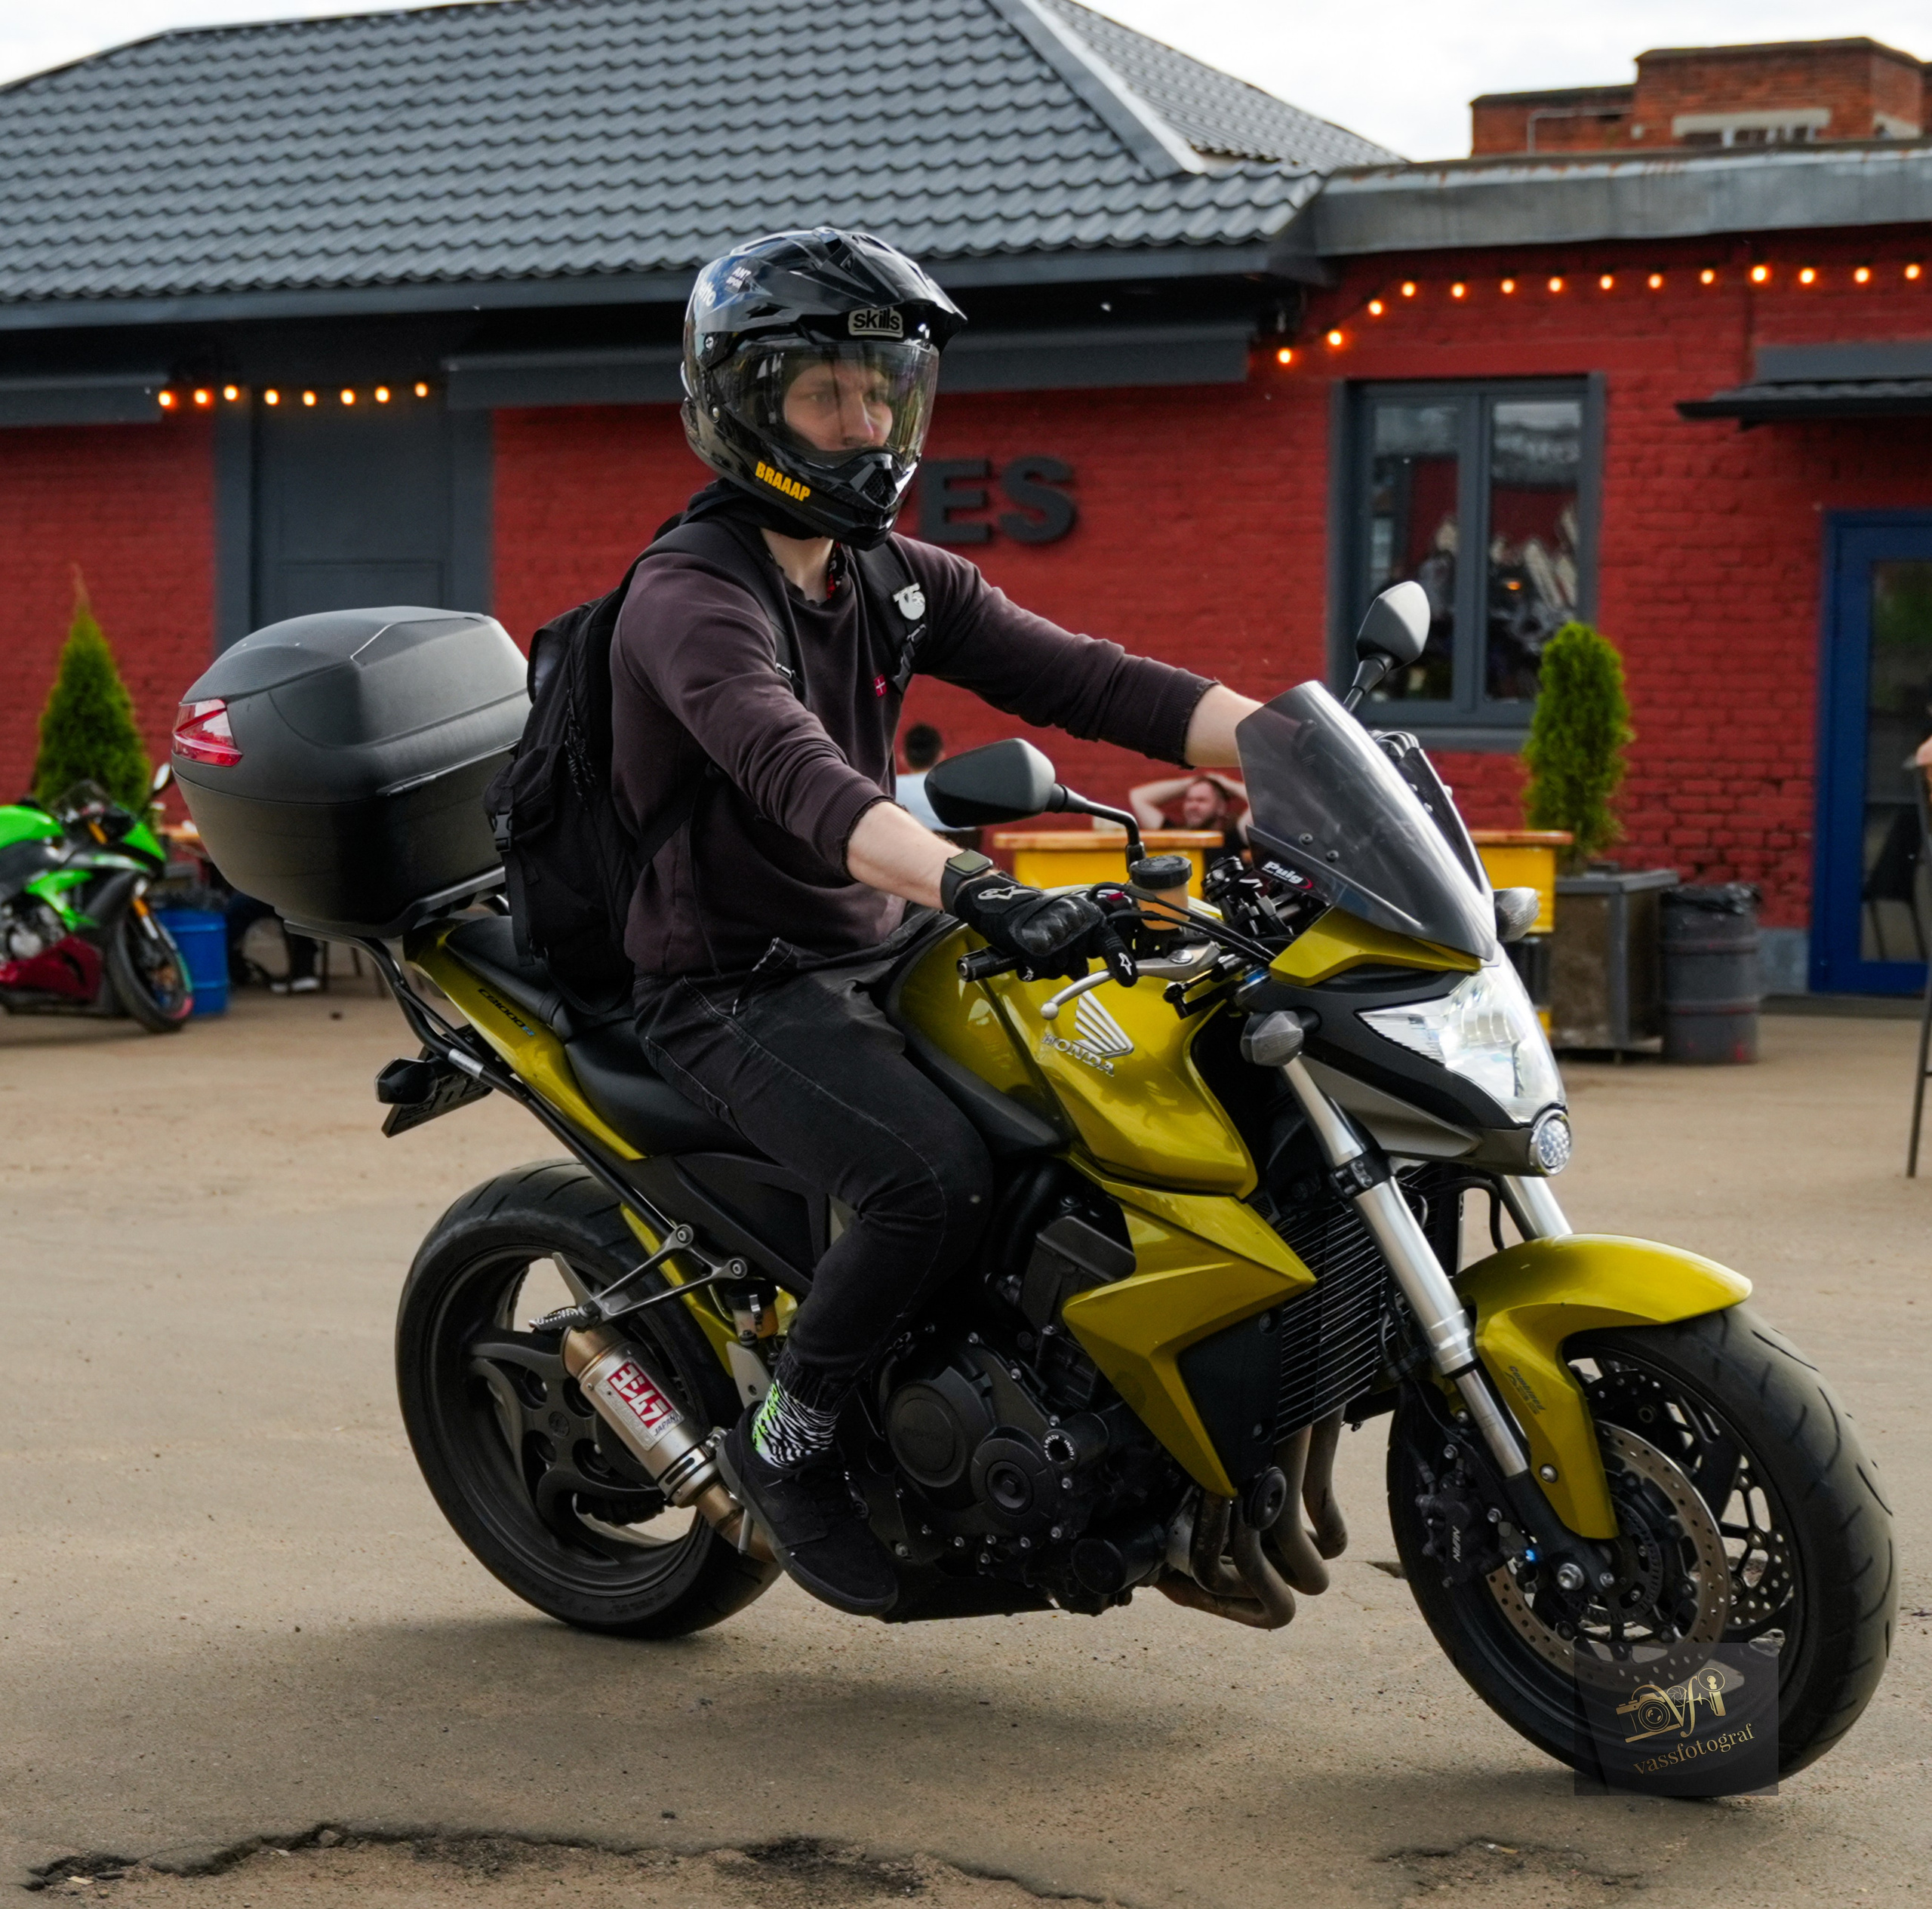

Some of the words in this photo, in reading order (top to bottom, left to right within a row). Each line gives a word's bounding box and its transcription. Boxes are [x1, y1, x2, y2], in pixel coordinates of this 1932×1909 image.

[853, 307, 900, 330] skills
[755, 460, 811, 502] BRAAAP
[1262, 861, 1304, 884] Puig
[1041, 1032, 1115, 1077] HONDA
[610, 1363, 670, 1422] ヨシムラ
[654, 1413, 679, 1437] JAPAN
